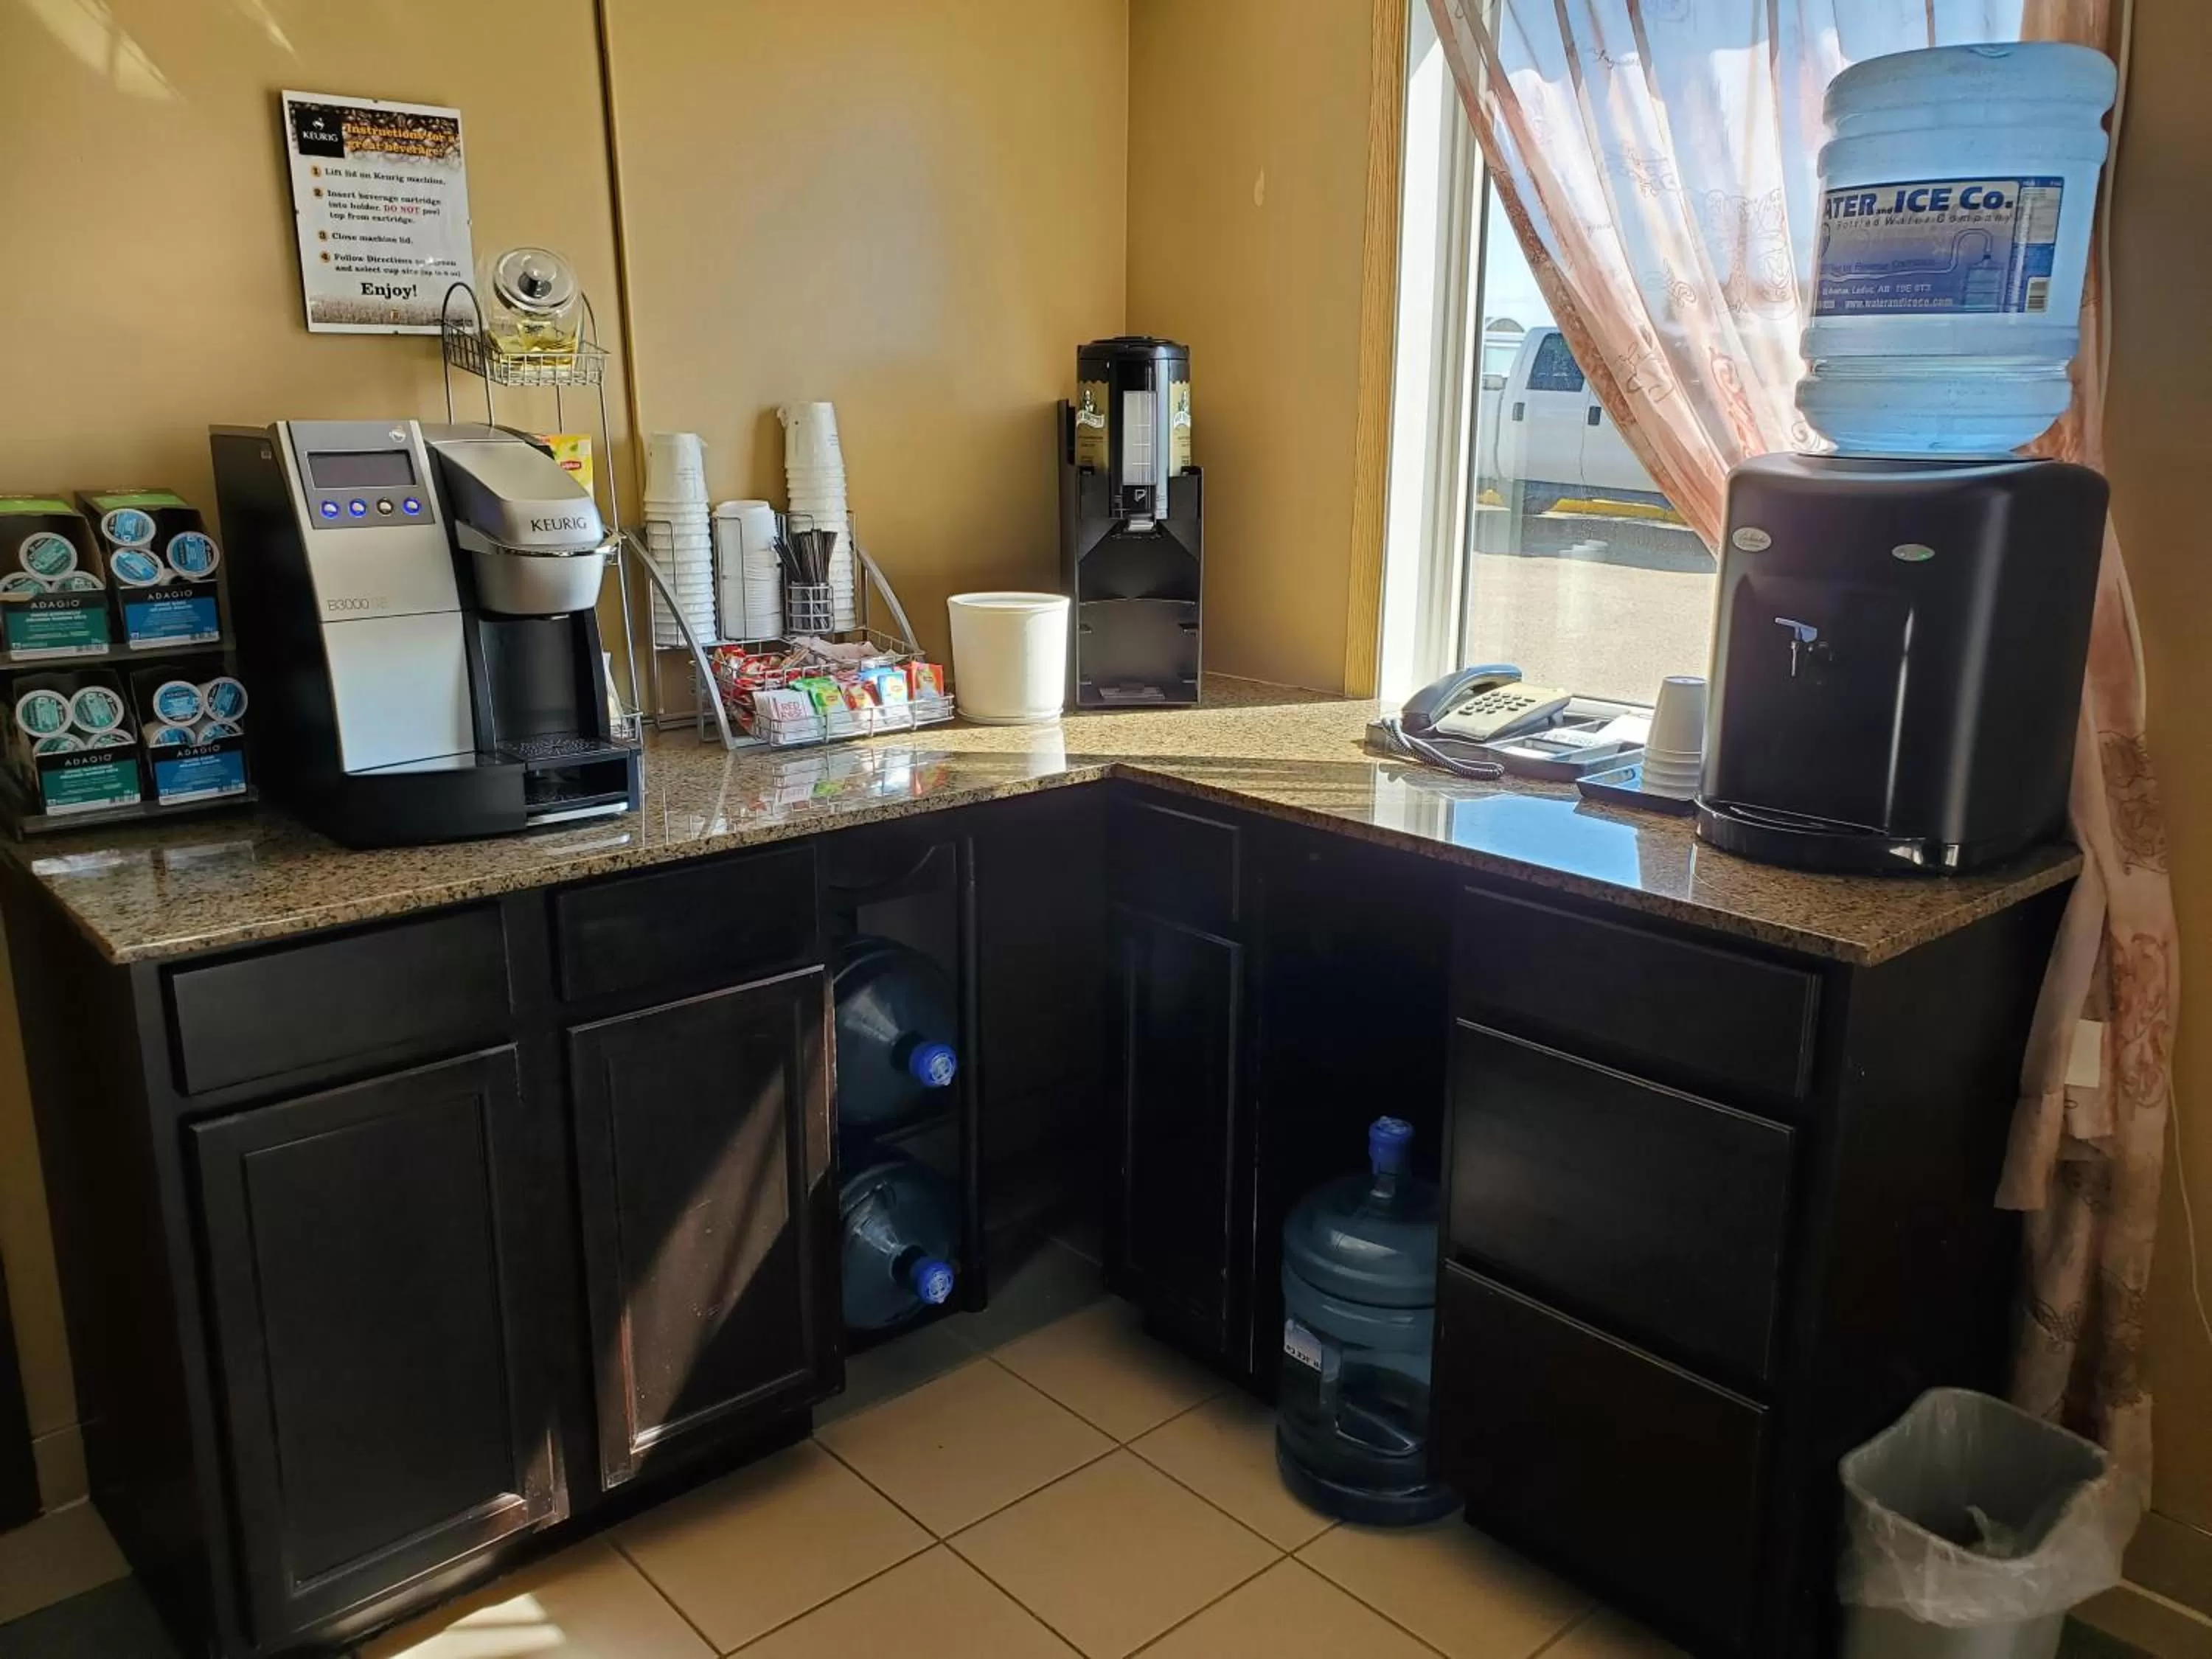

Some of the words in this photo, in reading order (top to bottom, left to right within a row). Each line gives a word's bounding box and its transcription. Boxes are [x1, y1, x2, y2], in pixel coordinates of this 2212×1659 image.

[302, 131, 338, 142] KEURIG
[325, 168, 342, 177] Lift
[345, 170, 357, 178] lid
[374, 173, 404, 183] Keurig
[327, 190, 355, 198] Insert
[358, 192, 398, 202] beverage
[401, 196, 441, 205] cartridge
[1876, 207, 1893, 215] and
[1894, 188, 1952, 213] ICE
[1959, 187, 2014, 209] Co.
[330, 212, 345, 220] top
[348, 212, 369, 220] from
[400, 206, 419, 215] NOT
[1937, 213, 2012, 224] Company
[332, 232, 357, 240] Close
[334, 254, 364, 262] Follow
[367, 255, 412, 264] Directions
[383, 268, 399, 276] cup
[361, 282, 417, 299] Enjoy!
[530, 517, 587, 532] KEURIG
[147, 590, 192, 600] ADAGIO
[30, 599, 80, 608] ADAGIO
[177, 745, 220, 757] ADAGIO
[65, 754, 112, 766] ADAGIO
